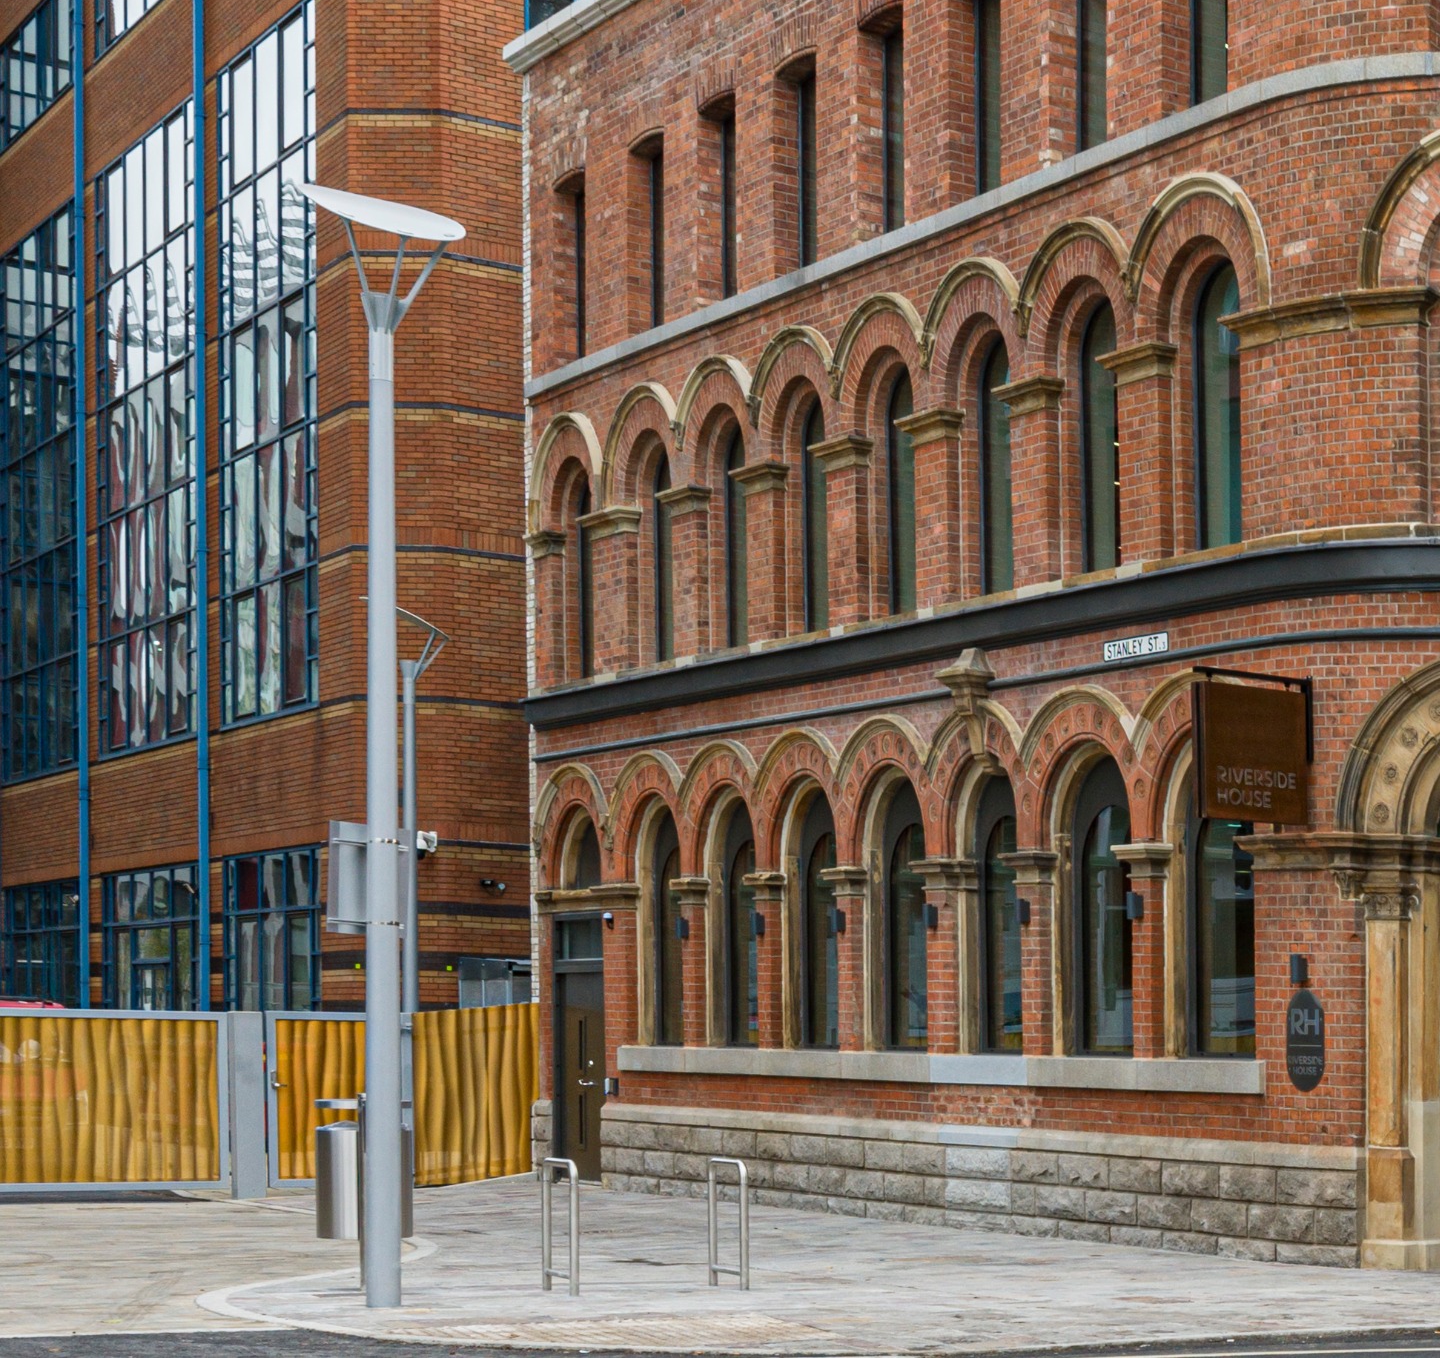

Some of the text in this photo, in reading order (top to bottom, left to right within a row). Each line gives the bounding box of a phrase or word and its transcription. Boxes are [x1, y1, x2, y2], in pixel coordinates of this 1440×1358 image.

[1107, 638, 1143, 659] STANLEY
[1216, 765, 1297, 790] RIVERSIDE
[1216, 786, 1272, 809] HOUSE
[1290, 1008, 1320, 1035] RH
[1288, 1055, 1323, 1065] RIVERSIDE
[1293, 1066, 1318, 1075] HOUSE
